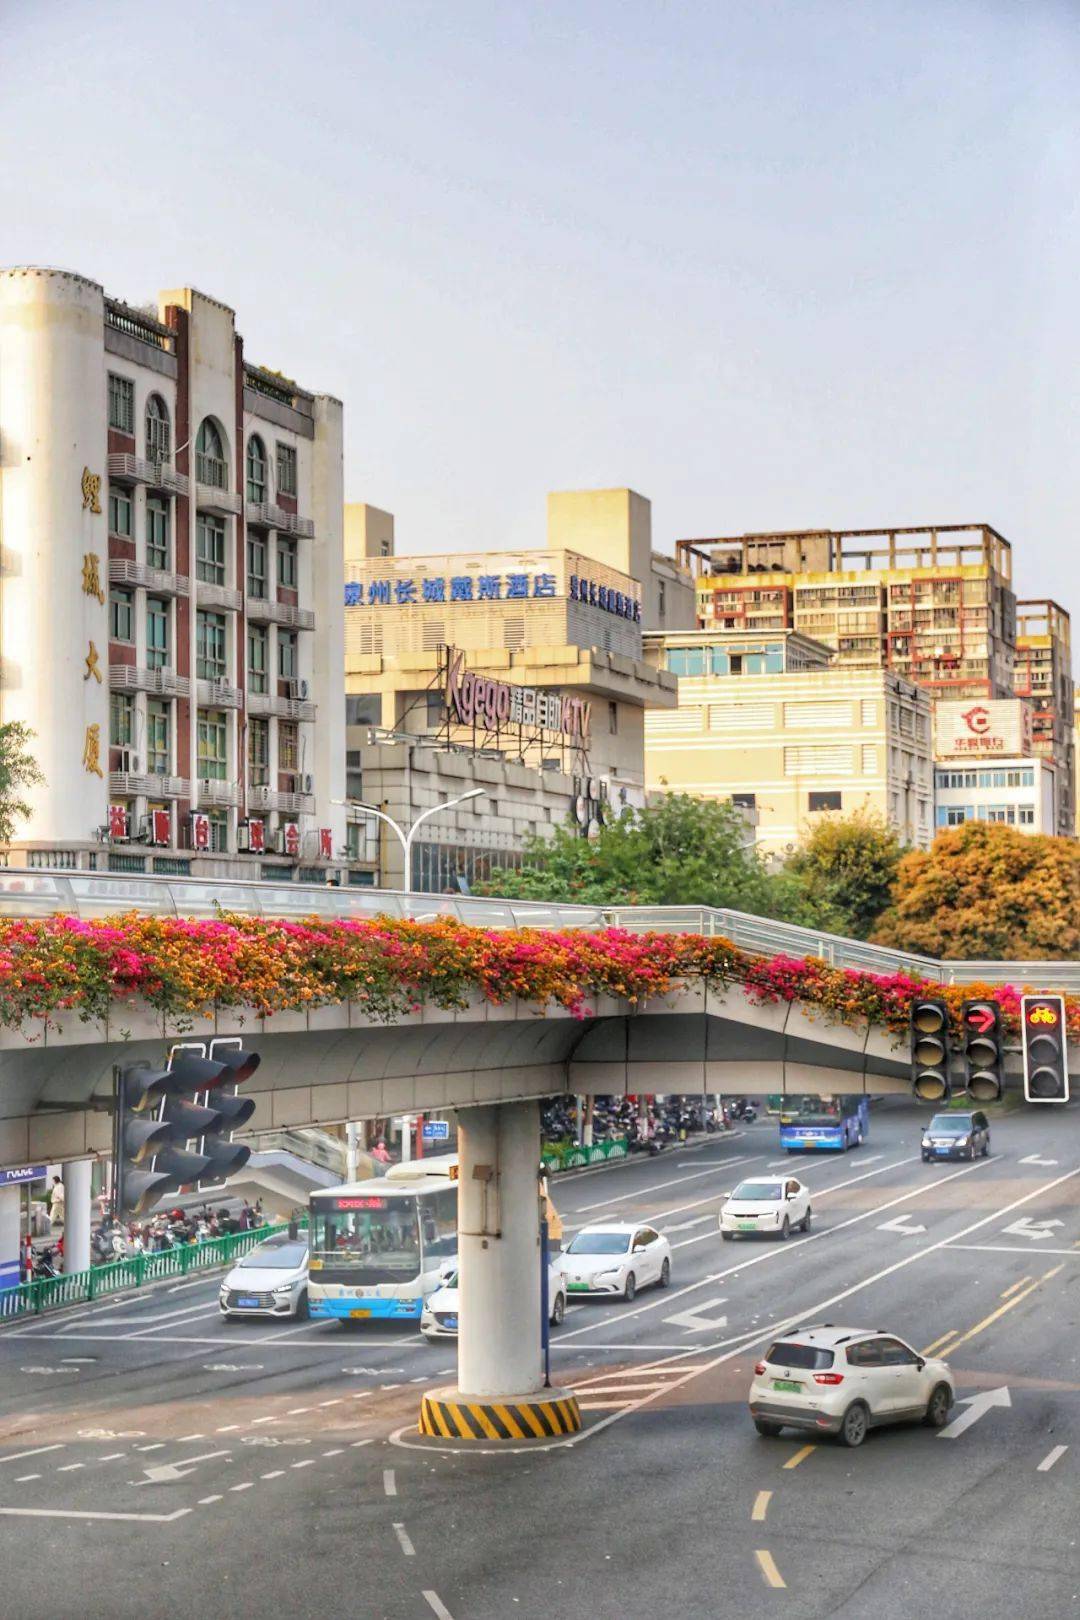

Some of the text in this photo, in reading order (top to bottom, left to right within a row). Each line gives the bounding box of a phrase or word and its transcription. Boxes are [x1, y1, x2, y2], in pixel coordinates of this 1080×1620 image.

[344, 573, 556, 606] 泉州长城戴斯酒店
